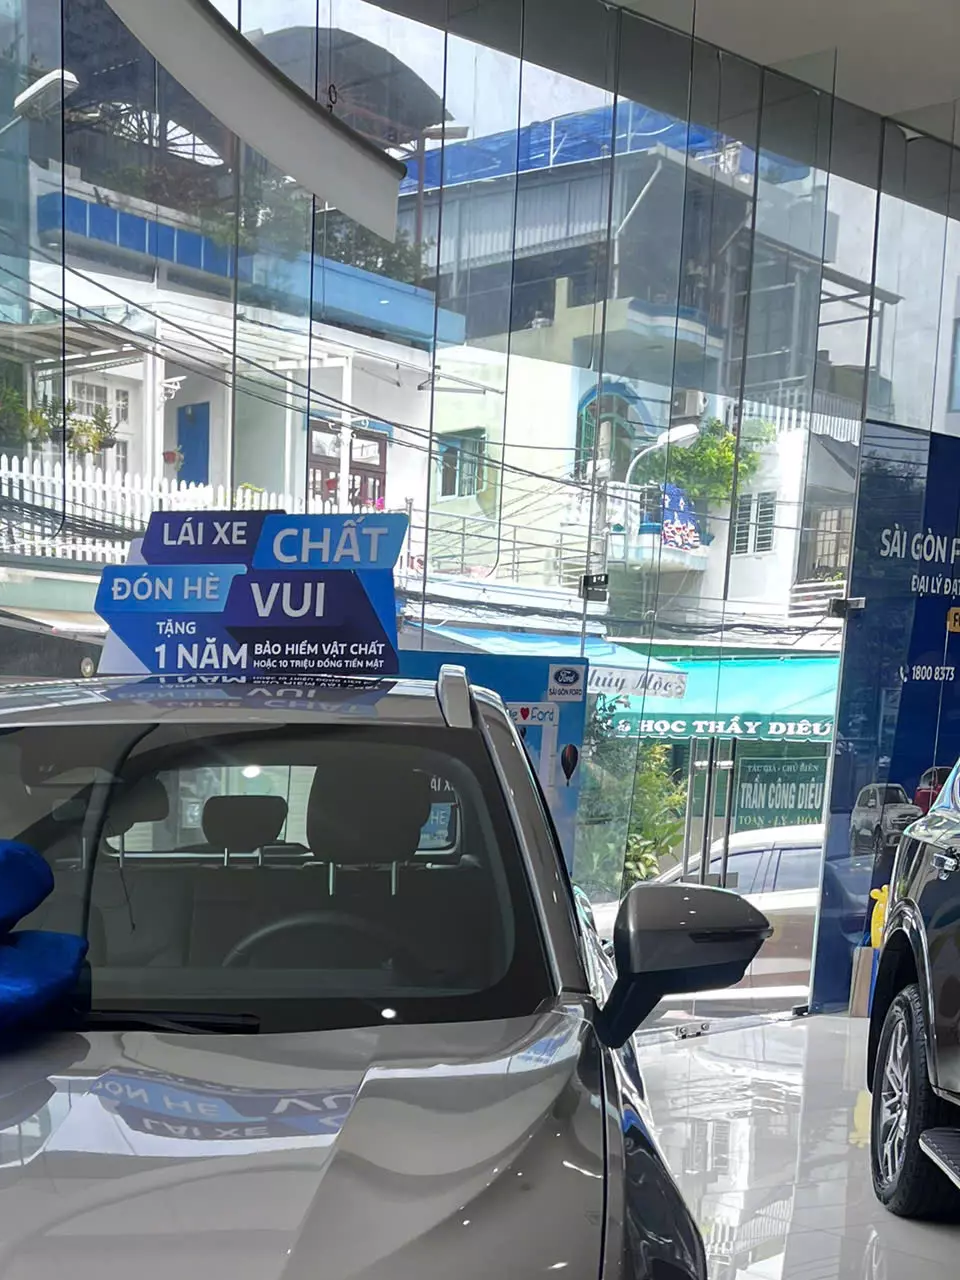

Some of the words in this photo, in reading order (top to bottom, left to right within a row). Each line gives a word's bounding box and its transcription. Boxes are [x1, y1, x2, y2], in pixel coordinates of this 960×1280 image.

[163, 517, 203, 545] LÁI
[213, 521, 247, 545] XE
[273, 516, 388, 563] CHẤT
[880, 523, 908, 559] SÀI
[911, 528, 947, 564] GÒN
[112, 573, 173, 601] ĐÓN
[183, 572, 220, 600] HÈ
[911, 574, 930, 597] ĐẠI
[931, 574, 943, 594] LÝ
[250, 582, 326, 618] VUI
[156, 619, 197, 636] TẶNG
[155, 644, 166, 670] 1
[177, 637, 248, 670] NĂM
[254, 640, 282, 655] BẢO
[285, 640, 319, 655] HIỂM
[322, 641, 348, 657] VẬT
[350, 640, 385, 655] CHẤT
[253, 659, 277, 670] HOẶC
[279, 660, 289, 669] 10
[290, 659, 316, 670] TRIỆU
[317, 657, 343, 669] ĐỒNG
[912, 666, 932, 681] 1800
[934, 666, 955, 681] 8373
[588, 669, 626, 692] húy
[637, 719, 687, 735] HỌC
[768, 777, 796, 809] CÔNG
